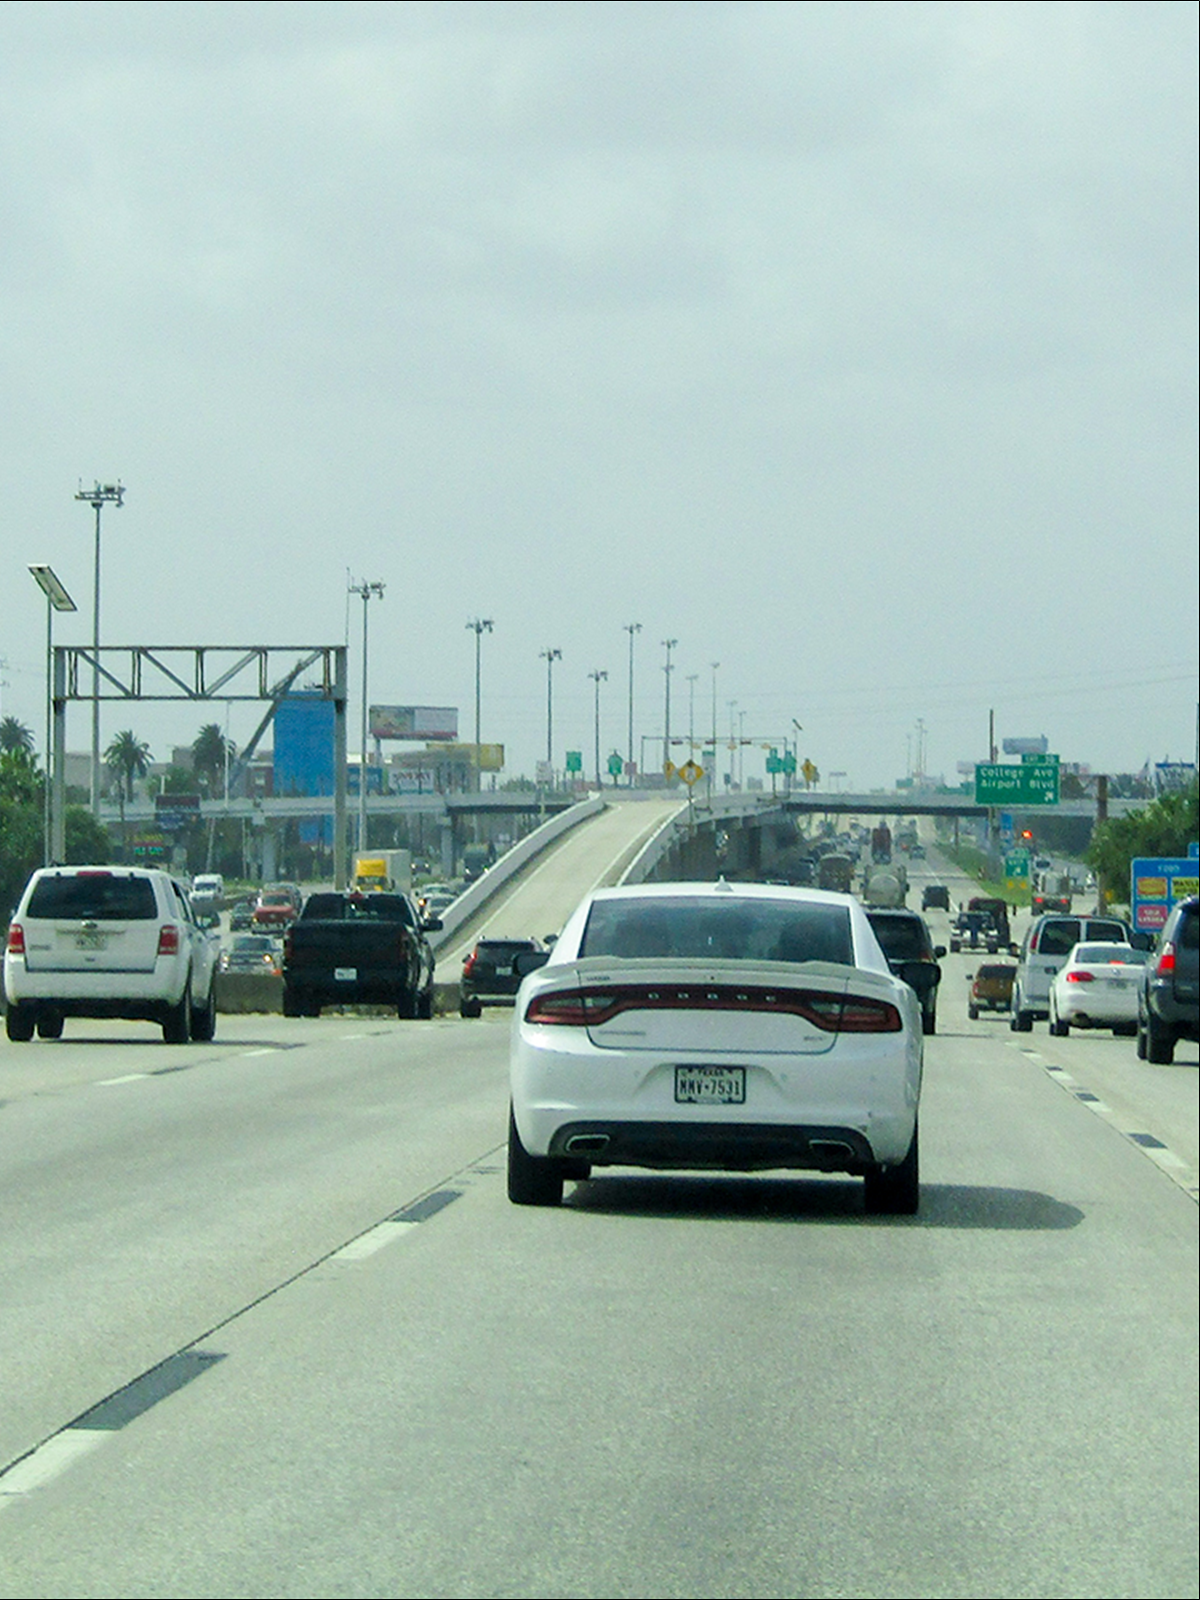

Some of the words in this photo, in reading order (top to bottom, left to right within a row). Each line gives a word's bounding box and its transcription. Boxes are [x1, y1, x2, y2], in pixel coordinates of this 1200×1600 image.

[980, 766, 1025, 779] College
[1033, 767, 1054, 778] Ave
[980, 779, 1021, 790] Airport
[1029, 779, 1055, 790] Blvd
